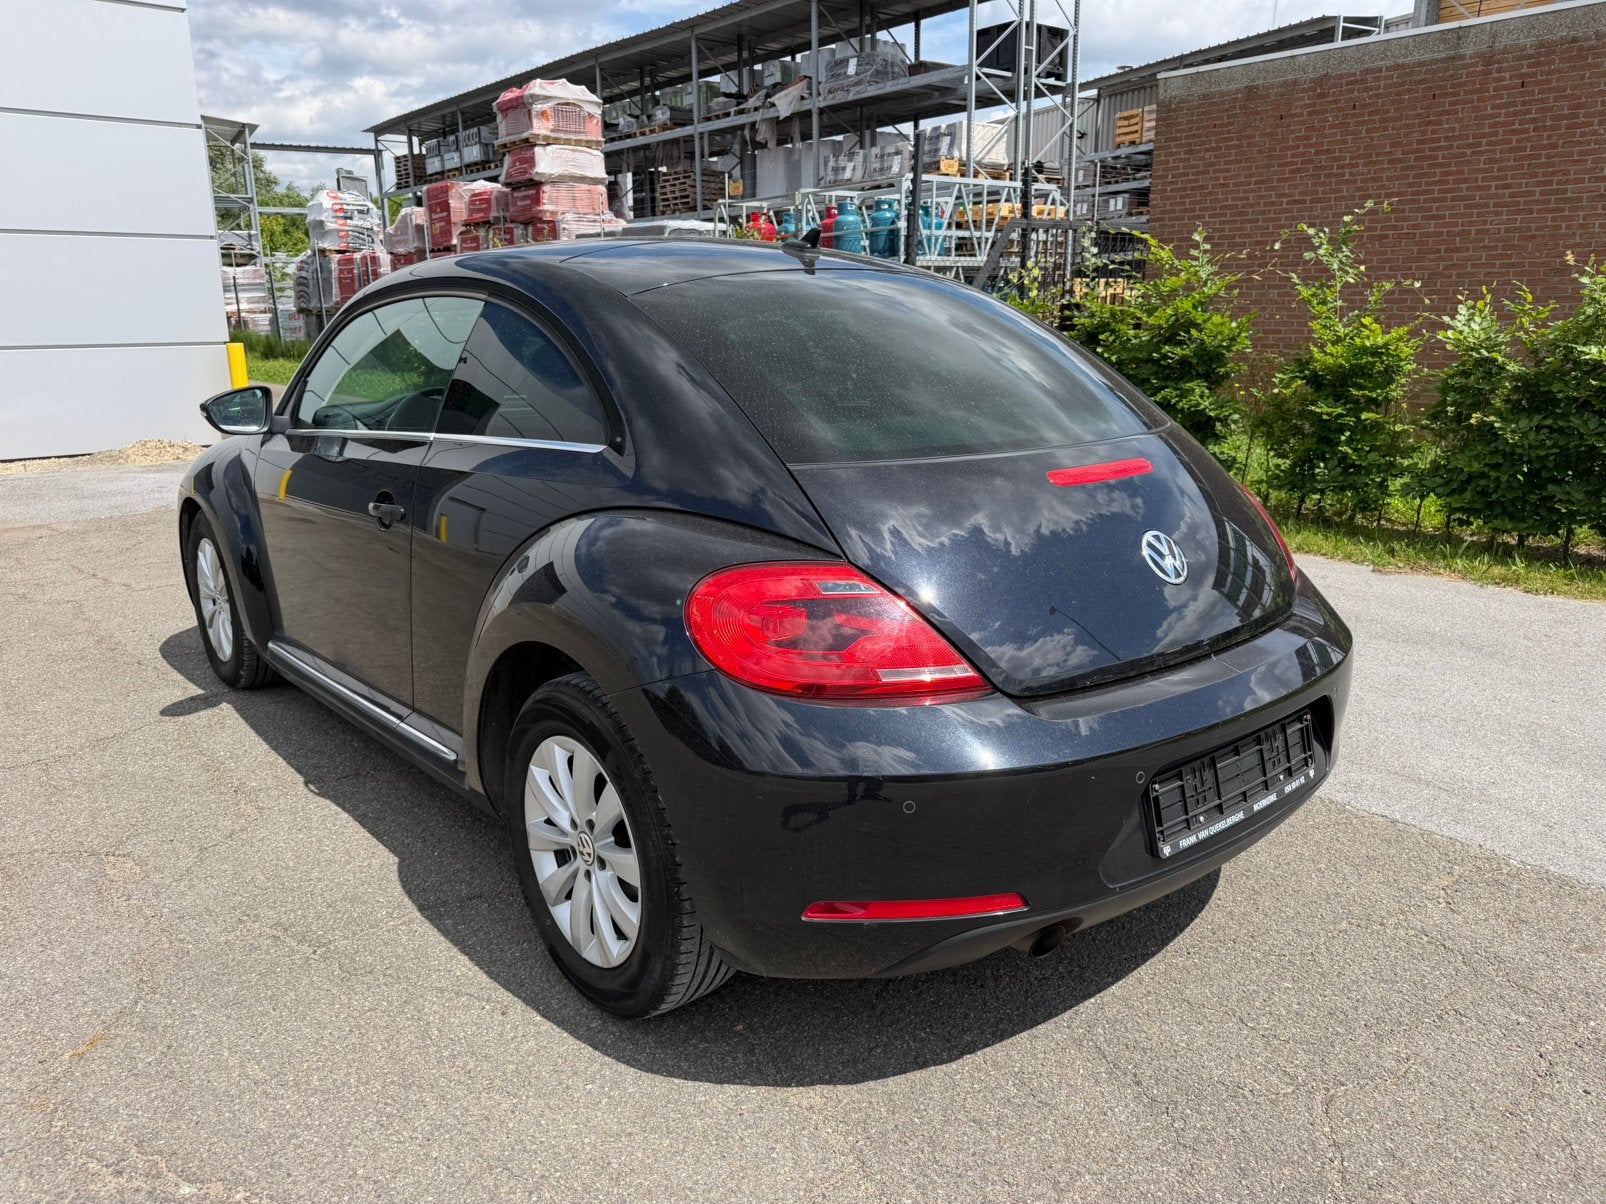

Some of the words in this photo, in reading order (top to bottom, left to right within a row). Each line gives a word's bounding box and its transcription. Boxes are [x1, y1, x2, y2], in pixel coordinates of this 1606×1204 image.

[874, 148, 904, 160] Koramic
[1179, 835, 1199, 849] FRANK
[1198, 829, 1209, 840] VAN
